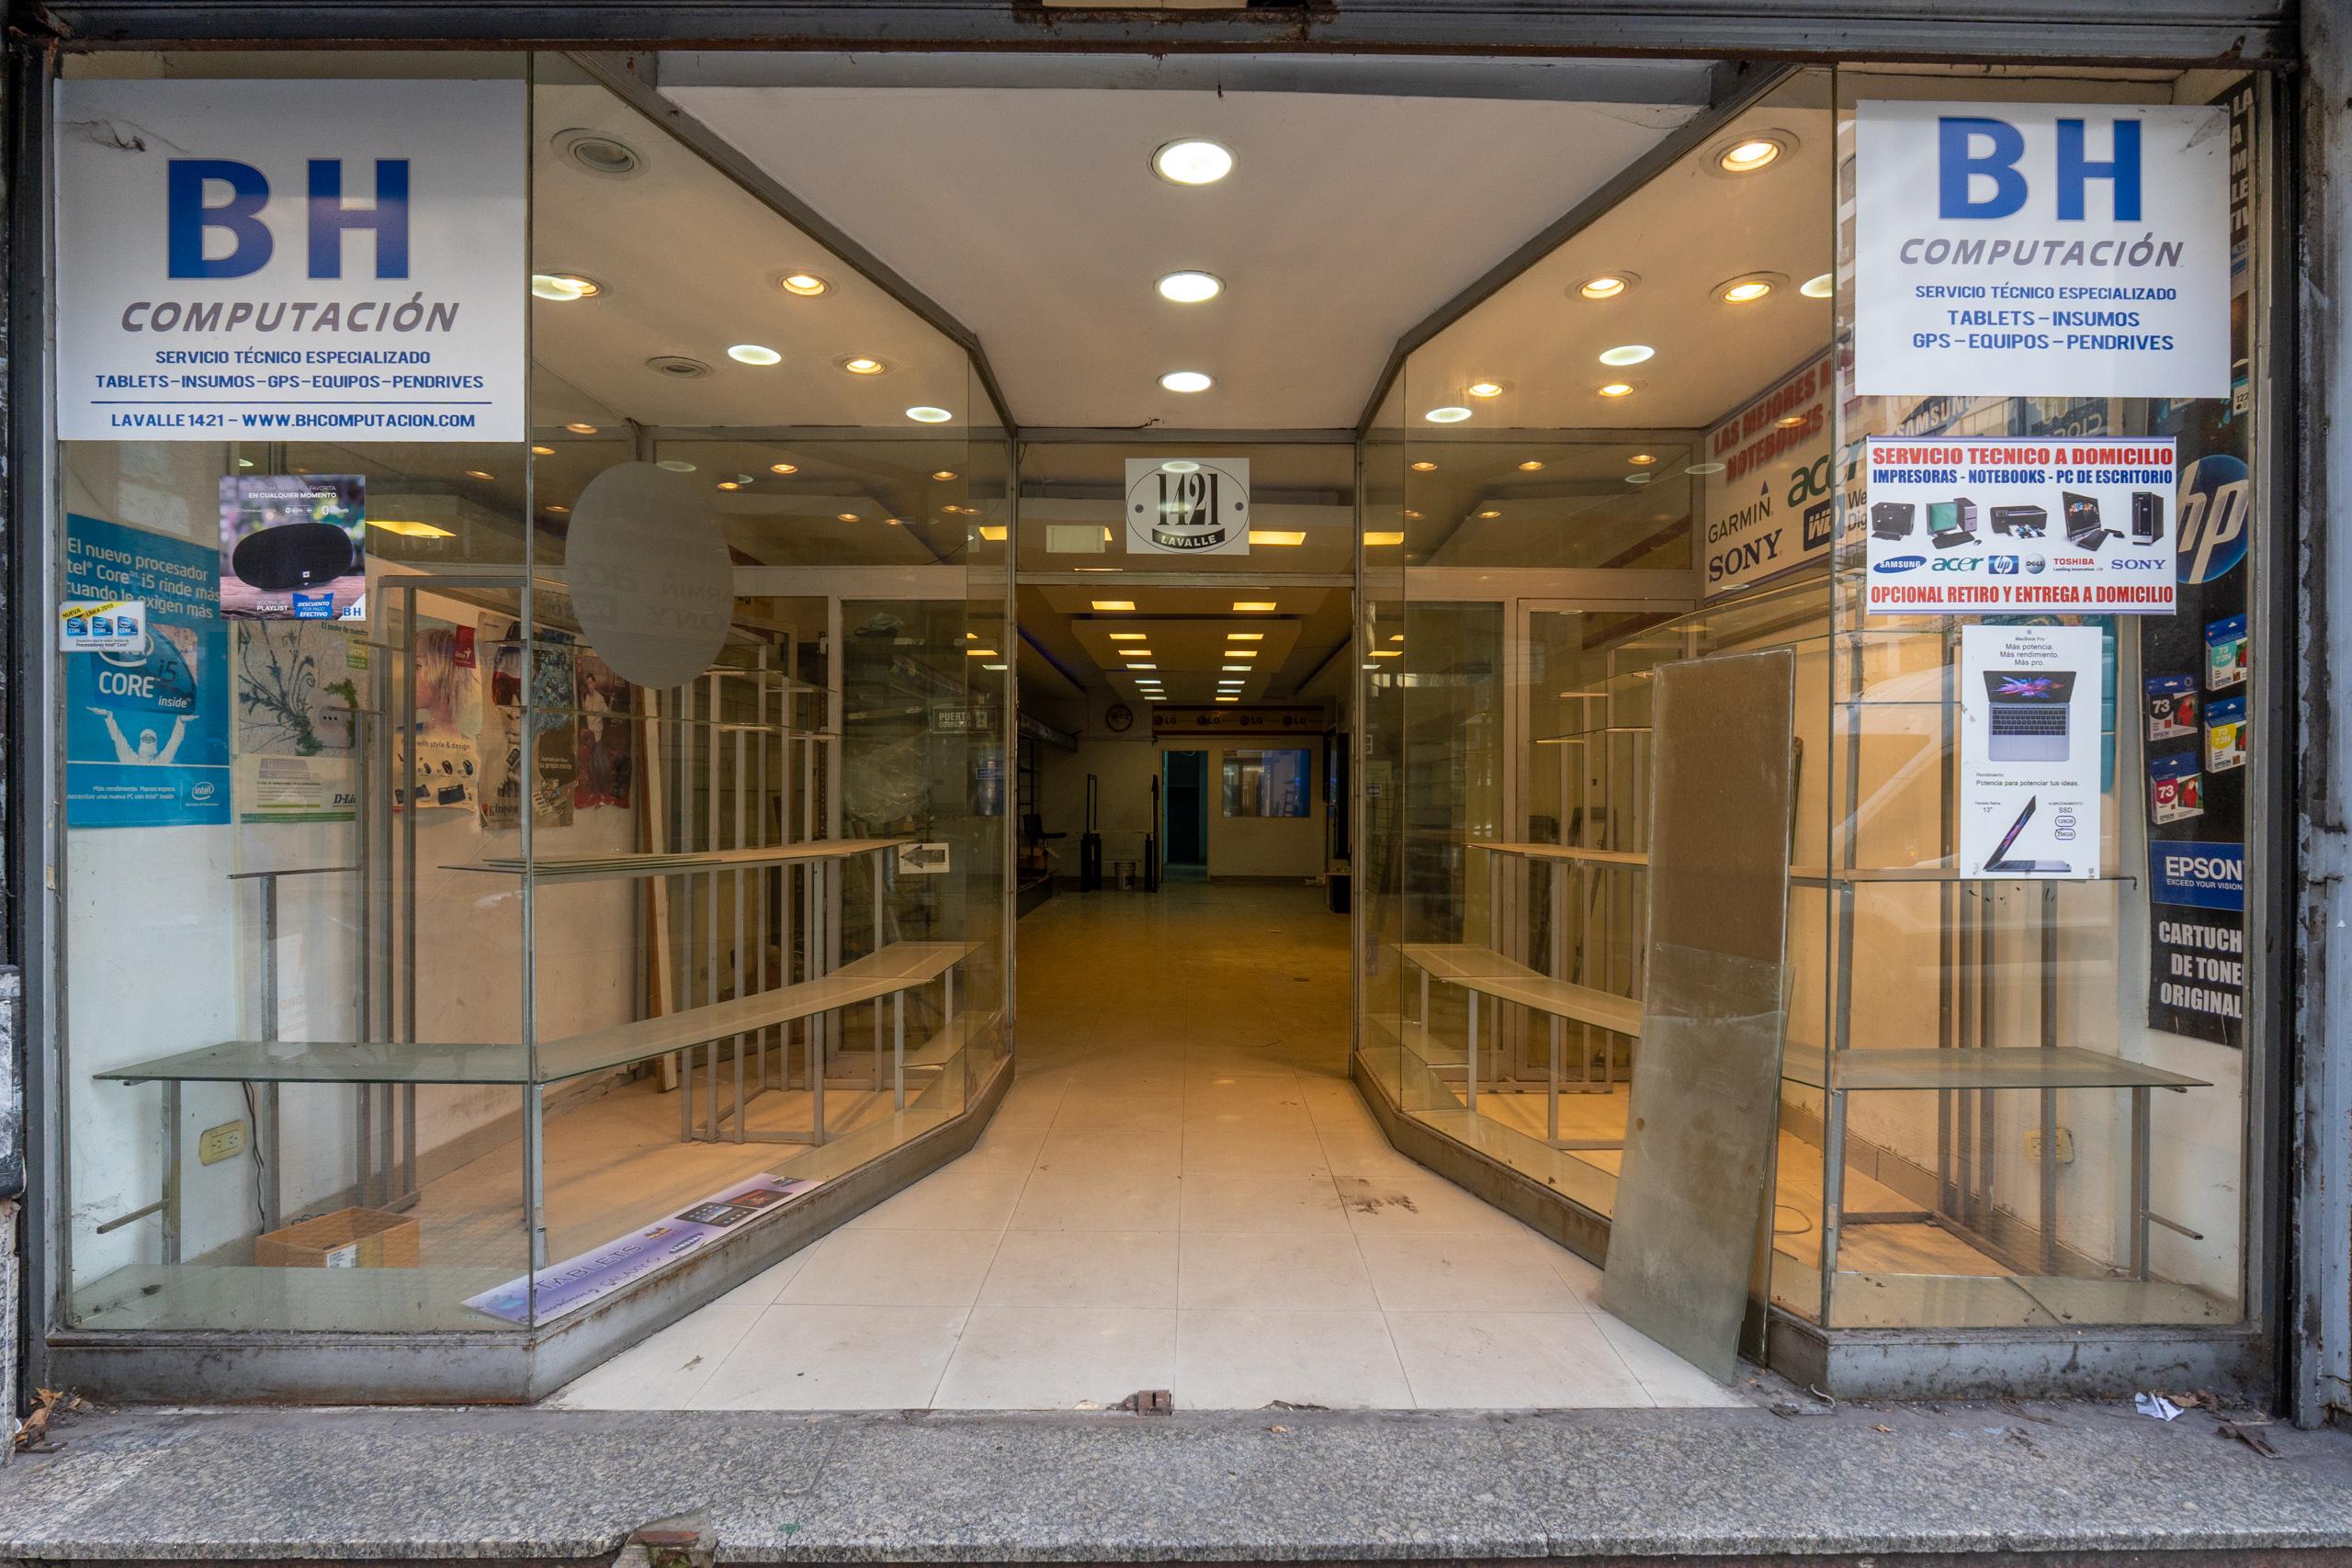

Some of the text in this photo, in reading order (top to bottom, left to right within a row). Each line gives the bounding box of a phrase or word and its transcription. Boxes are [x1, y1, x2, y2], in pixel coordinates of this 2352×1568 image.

[1938, 115, 2143, 222] BH
[166, 157, 411, 280] BH
[1899, 232, 2185, 267] COMPUTACIÓN
[1916, 281, 2177, 300] SERVICIO TÉCNICO ESPECIALIZADO
[120, 291, 460, 333] COMPUTACIÓN
[1947, 310, 2140, 327] TABLETS INSUMOS
[1913, 333, 2175, 351] GPS EQUIPOS PENDRIVES
[155, 345, 431, 365] SERVICIO TÉCNICO ESPECIALIZADO
[111, 413, 475, 428] LAVALLE 1421 WWW.BHCOMPUTACION.COM
[1896, 397, 1971, 436] SAMSUN
[1872, 447, 2174, 466] SERVICIO TECNICO A DOMICILIO
[1872, 469, 2173, 484] IMPRESORAS NOTEBOOKS PC DE ESCRITORIO
[1156, 472, 1221, 526] 1421
[1708, 497, 1772, 545] GARMIN
[1160, 534, 1216, 547] LAVALLE
[67, 537, 208, 581] El nuevo procesador
[1708, 528, 1783, 583] SONY
[1880, 560, 1921, 569] SAMSUNG
[1931, 557, 1984, 571] acer
[2053, 558, 2095, 566] TOSHIBA
[2111, 558, 2166, 570] SONY
[141, 572, 155, 590] i5
[159, 578, 192, 597] rinde
[196, 585, 220, 603] más
[1871, 586, 2174, 604] OPCIONAL RETIRO Y ENTREGA A DOMICILIO
[62, 607, 82, 618] NUEVA
[187, 604, 213, 619] más
[343, 607, 361, 616] BH
[2152, 698, 2170, 714] 73
[2158, 784, 2175, 798] 73
[2165, 855, 2243, 881] EPSON
[2166, 878, 2243, 891] EXCEED YOUR VISION
[2159, 920, 2243, 953] CARTUCH
[2171, 953, 2243, 987] DE TONE
[534, 1244, 642, 1291] TABLETS
